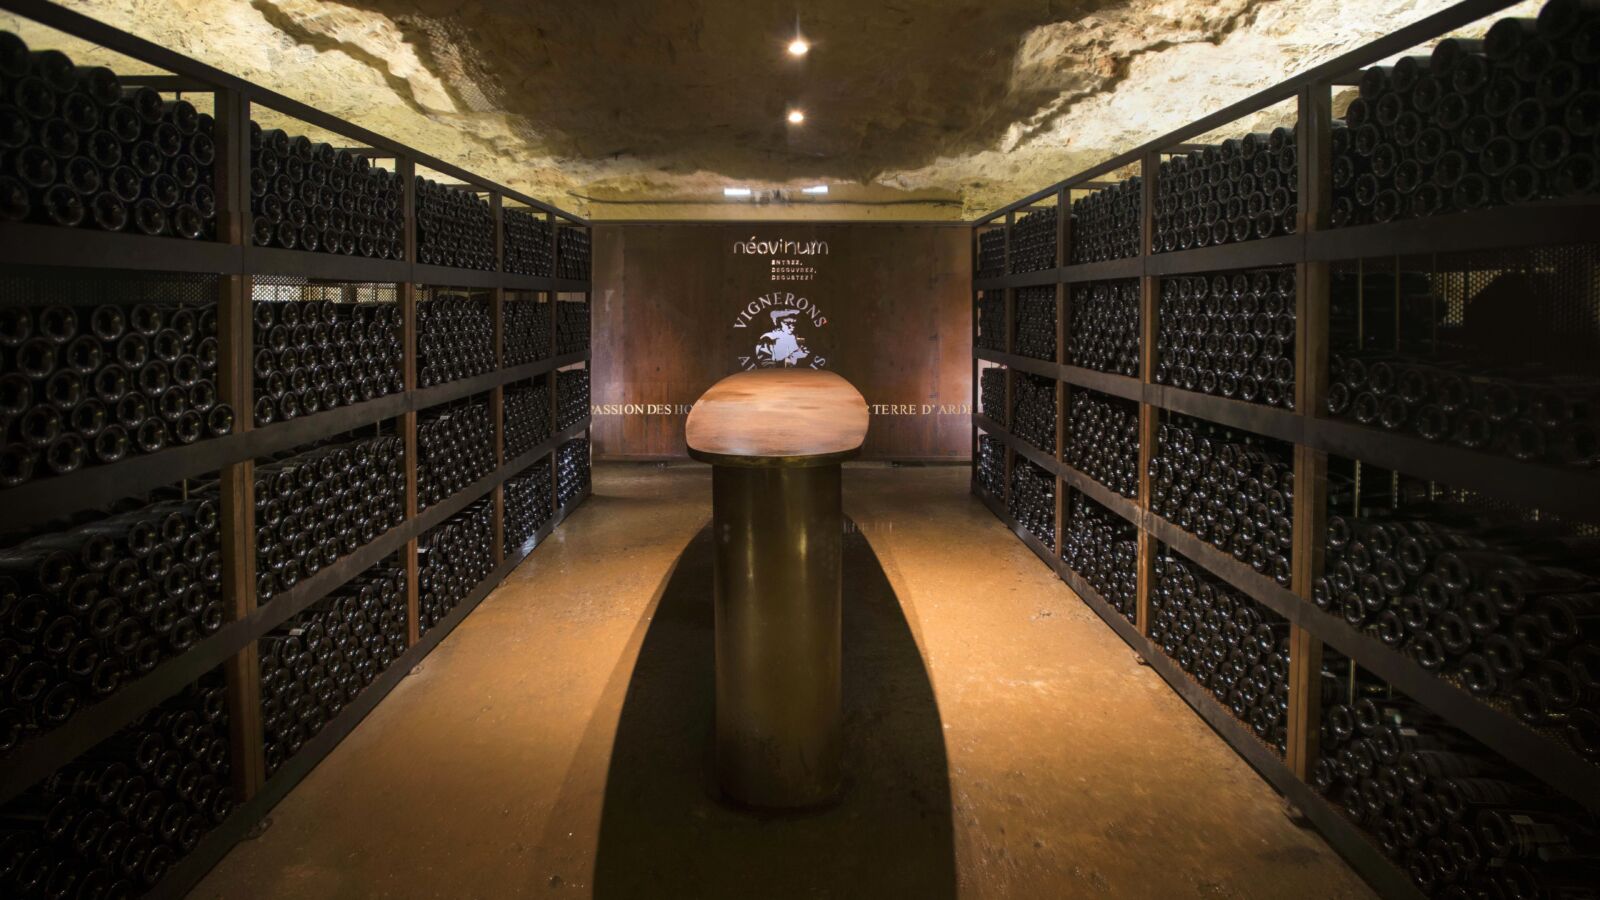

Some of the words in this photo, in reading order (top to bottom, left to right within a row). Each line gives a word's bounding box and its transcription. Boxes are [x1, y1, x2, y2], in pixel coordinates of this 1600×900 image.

[733, 236, 829, 255] néovinum
[733, 291, 828, 328] VIGNERONS
[647, 404, 672, 415] DES
[872, 404, 917, 415] TERRE
